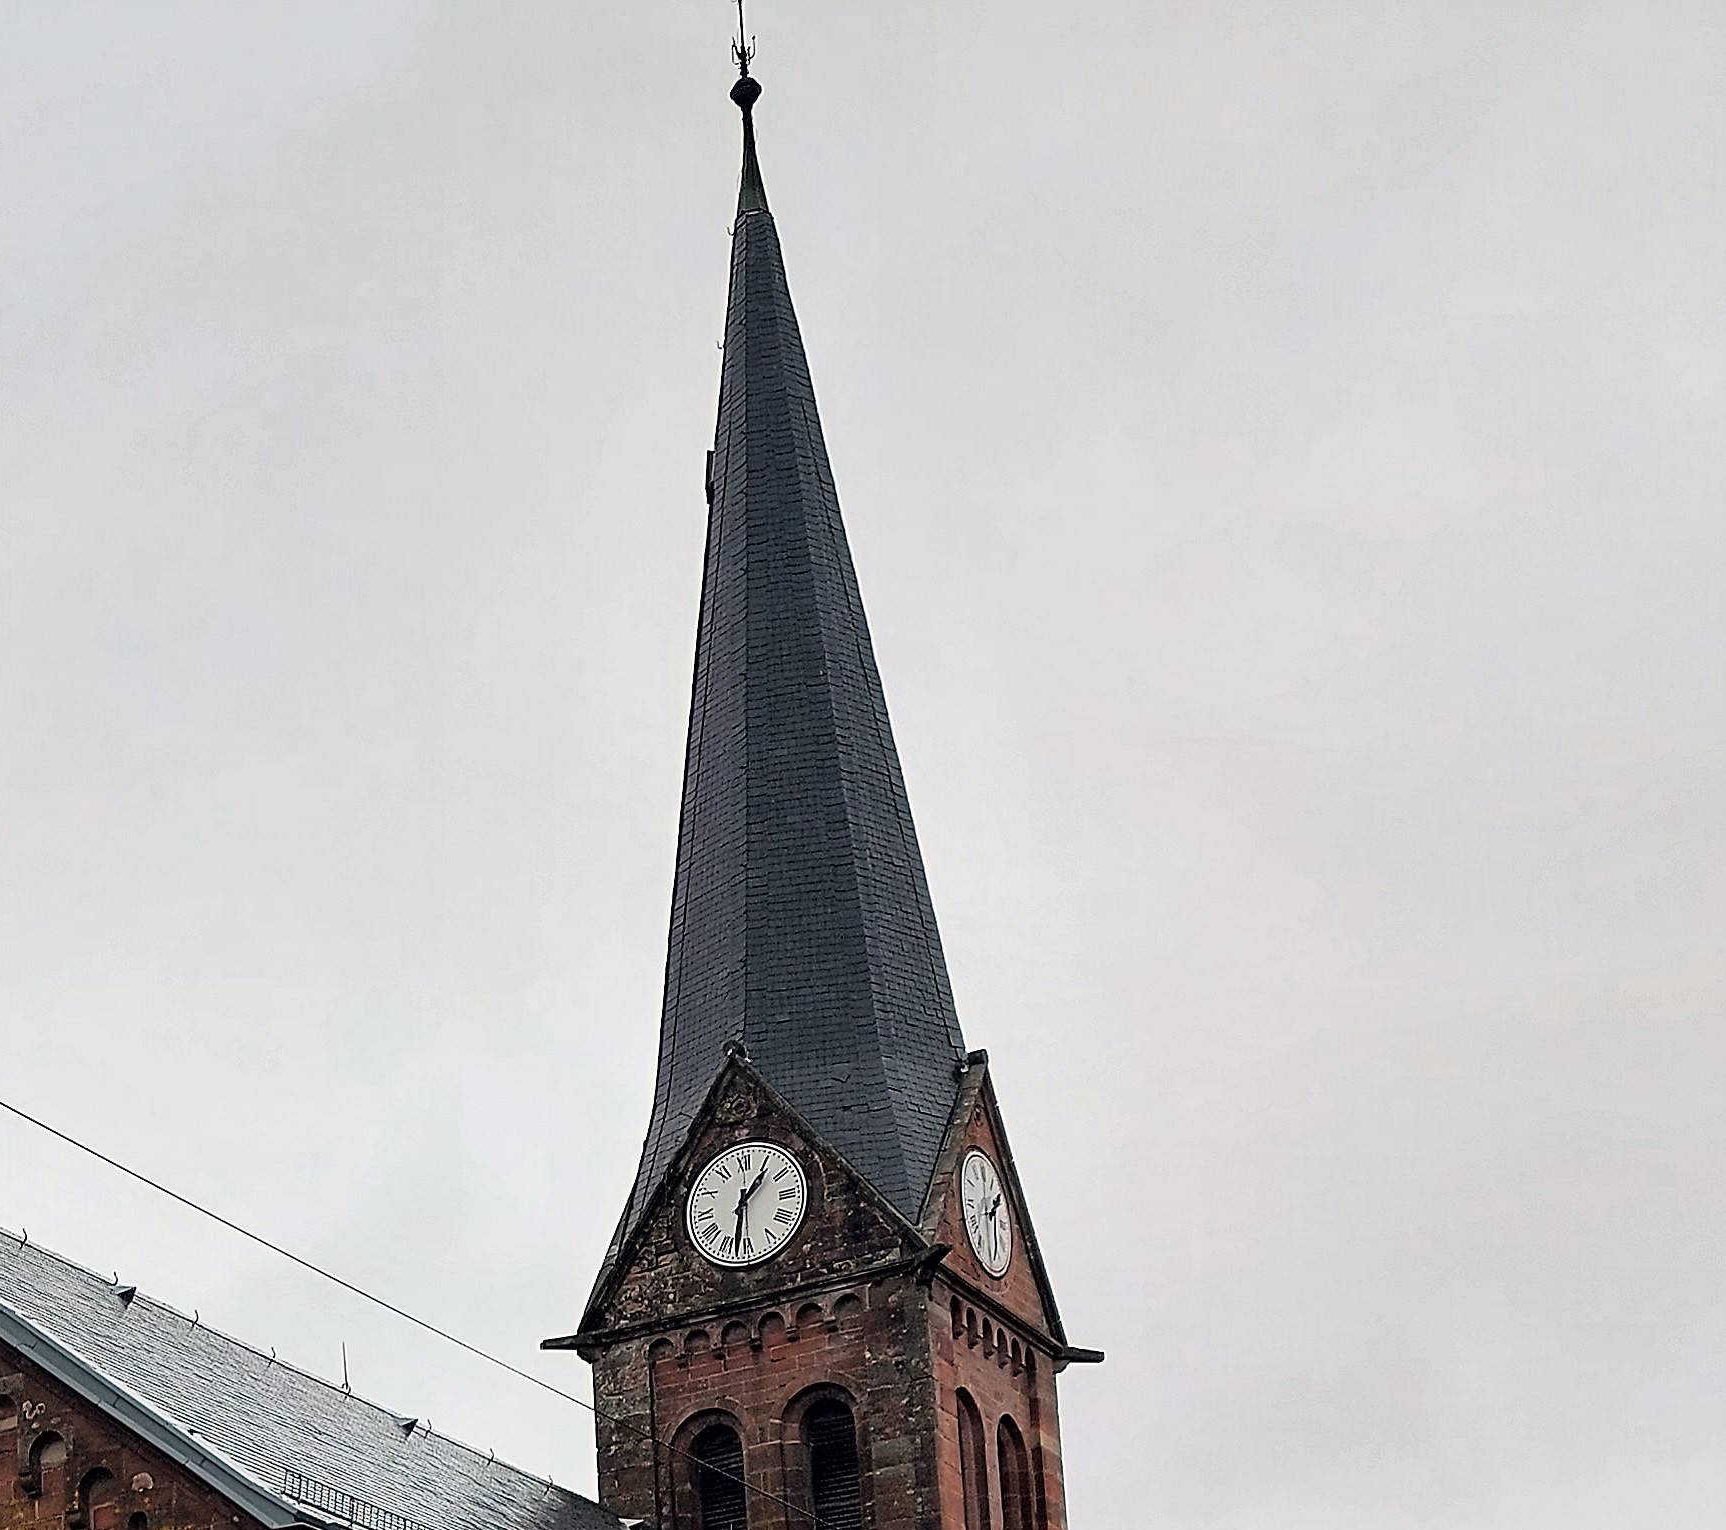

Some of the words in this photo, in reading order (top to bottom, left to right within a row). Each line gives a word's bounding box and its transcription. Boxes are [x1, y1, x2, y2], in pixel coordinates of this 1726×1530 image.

[737, 1154, 751, 1173] XII
[760, 1155, 769, 1171] I
[715, 1165, 732, 1183] XI
[773, 1167, 789, 1182] II
[779, 1187, 796, 1200] III
[698, 1208, 714, 1221] IX
[773, 1208, 793, 1224] IIII
[701, 1223, 721, 1244] VIII
[764, 1228, 776, 1244] V
